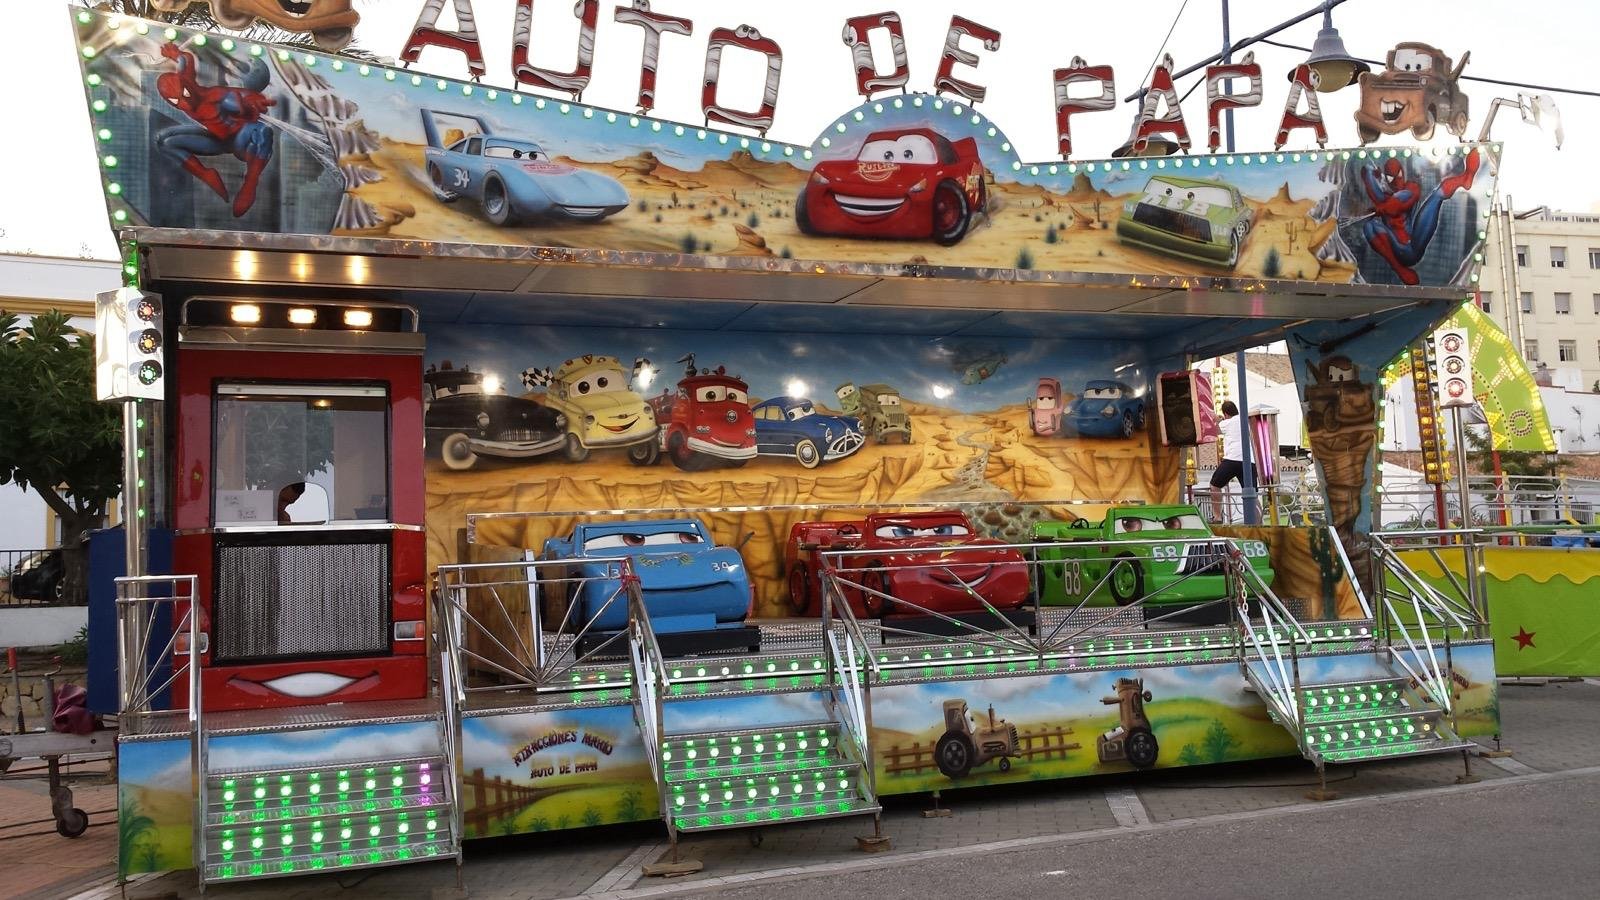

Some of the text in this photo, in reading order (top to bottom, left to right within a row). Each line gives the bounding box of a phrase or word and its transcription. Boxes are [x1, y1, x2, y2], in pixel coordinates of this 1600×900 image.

[401, 0, 1328, 154] AUTO DE PAPA
[453, 168, 470, 188] 34
[1152, 546, 1177, 562] 68
[1243, 542, 1267, 558] 68
[1063, 558, 1081, 596] 68
[530, 766, 554, 779] AUTO
[560, 765, 571, 775] DE
